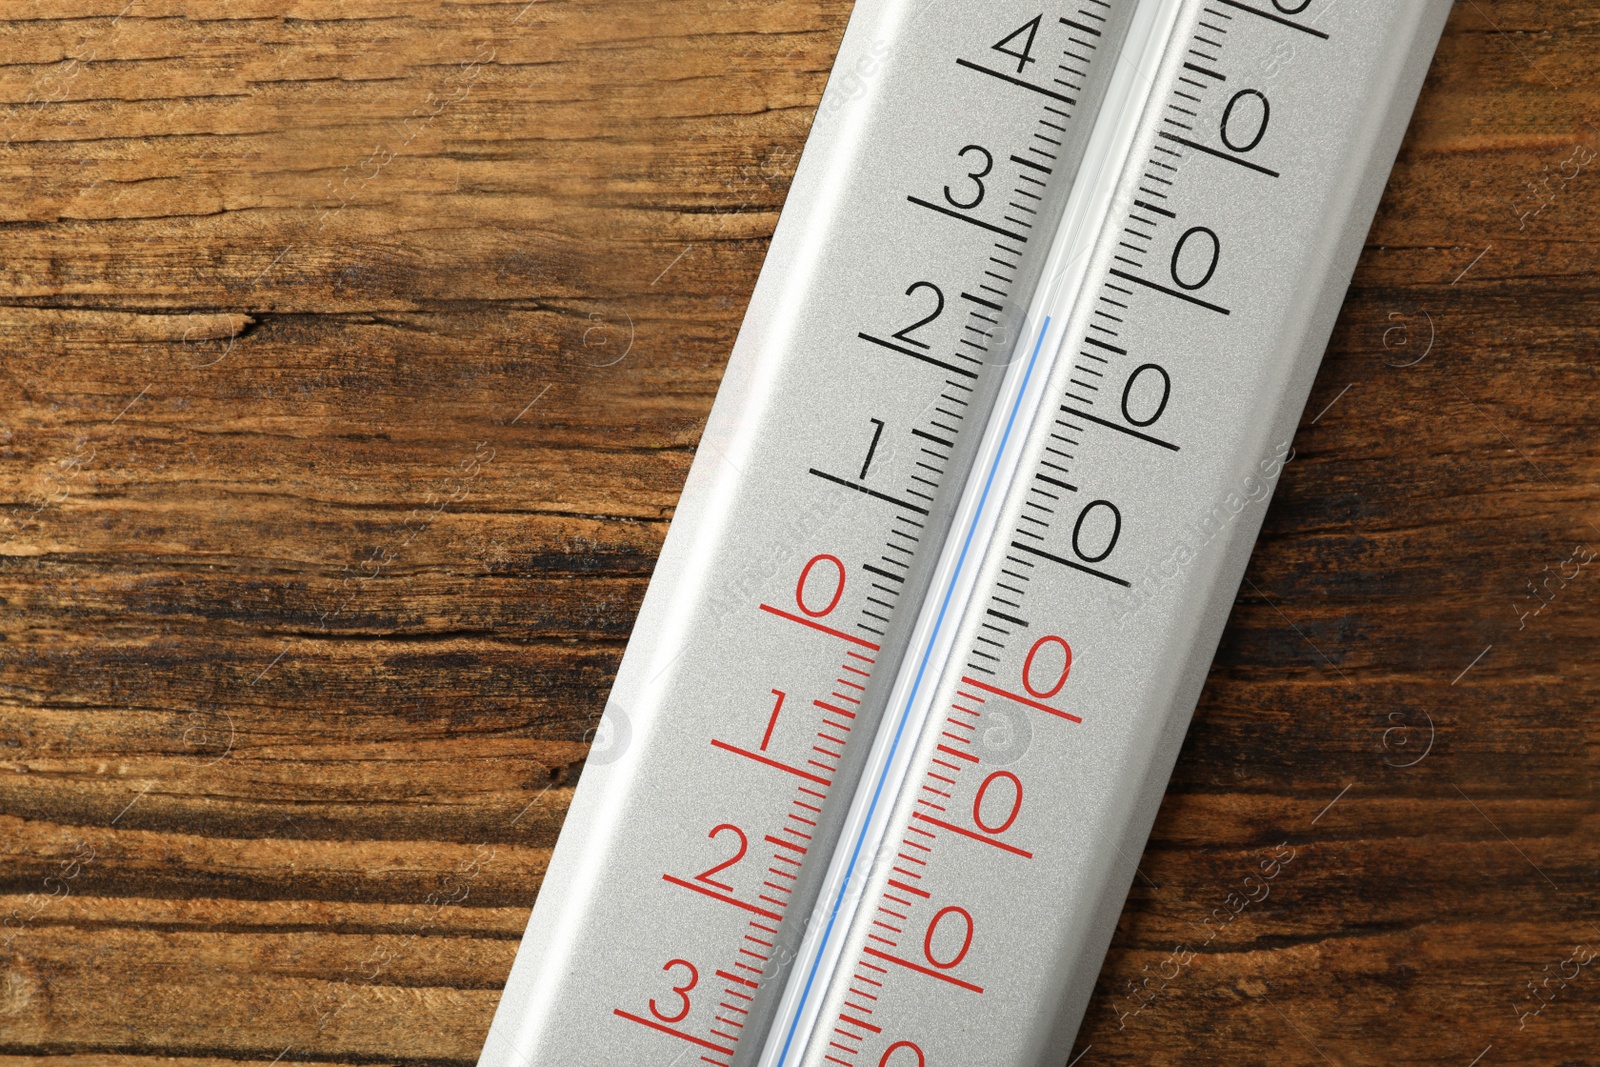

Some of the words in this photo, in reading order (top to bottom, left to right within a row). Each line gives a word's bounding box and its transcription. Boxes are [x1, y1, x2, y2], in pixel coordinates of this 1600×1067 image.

[991, 13, 1043, 73] 4
[1220, 89, 1270, 153] 0
[944, 145, 993, 209] 3
[1171, 226, 1220, 290] 0
[892, 281, 944, 349] 2
[1121, 364, 1171, 427] 0
[860, 418, 884, 480] 1
[1072, 500, 1121, 563] 0
[796, 554, 845, 617] 0
[1023, 635, 1072, 698] 0
[760, 689, 785, 751] 1
[973, 771, 1022, 834] 0
[695, 824, 747, 892] 2
[924, 906, 973, 969] 0
[649, 959, 698, 1023] 3
